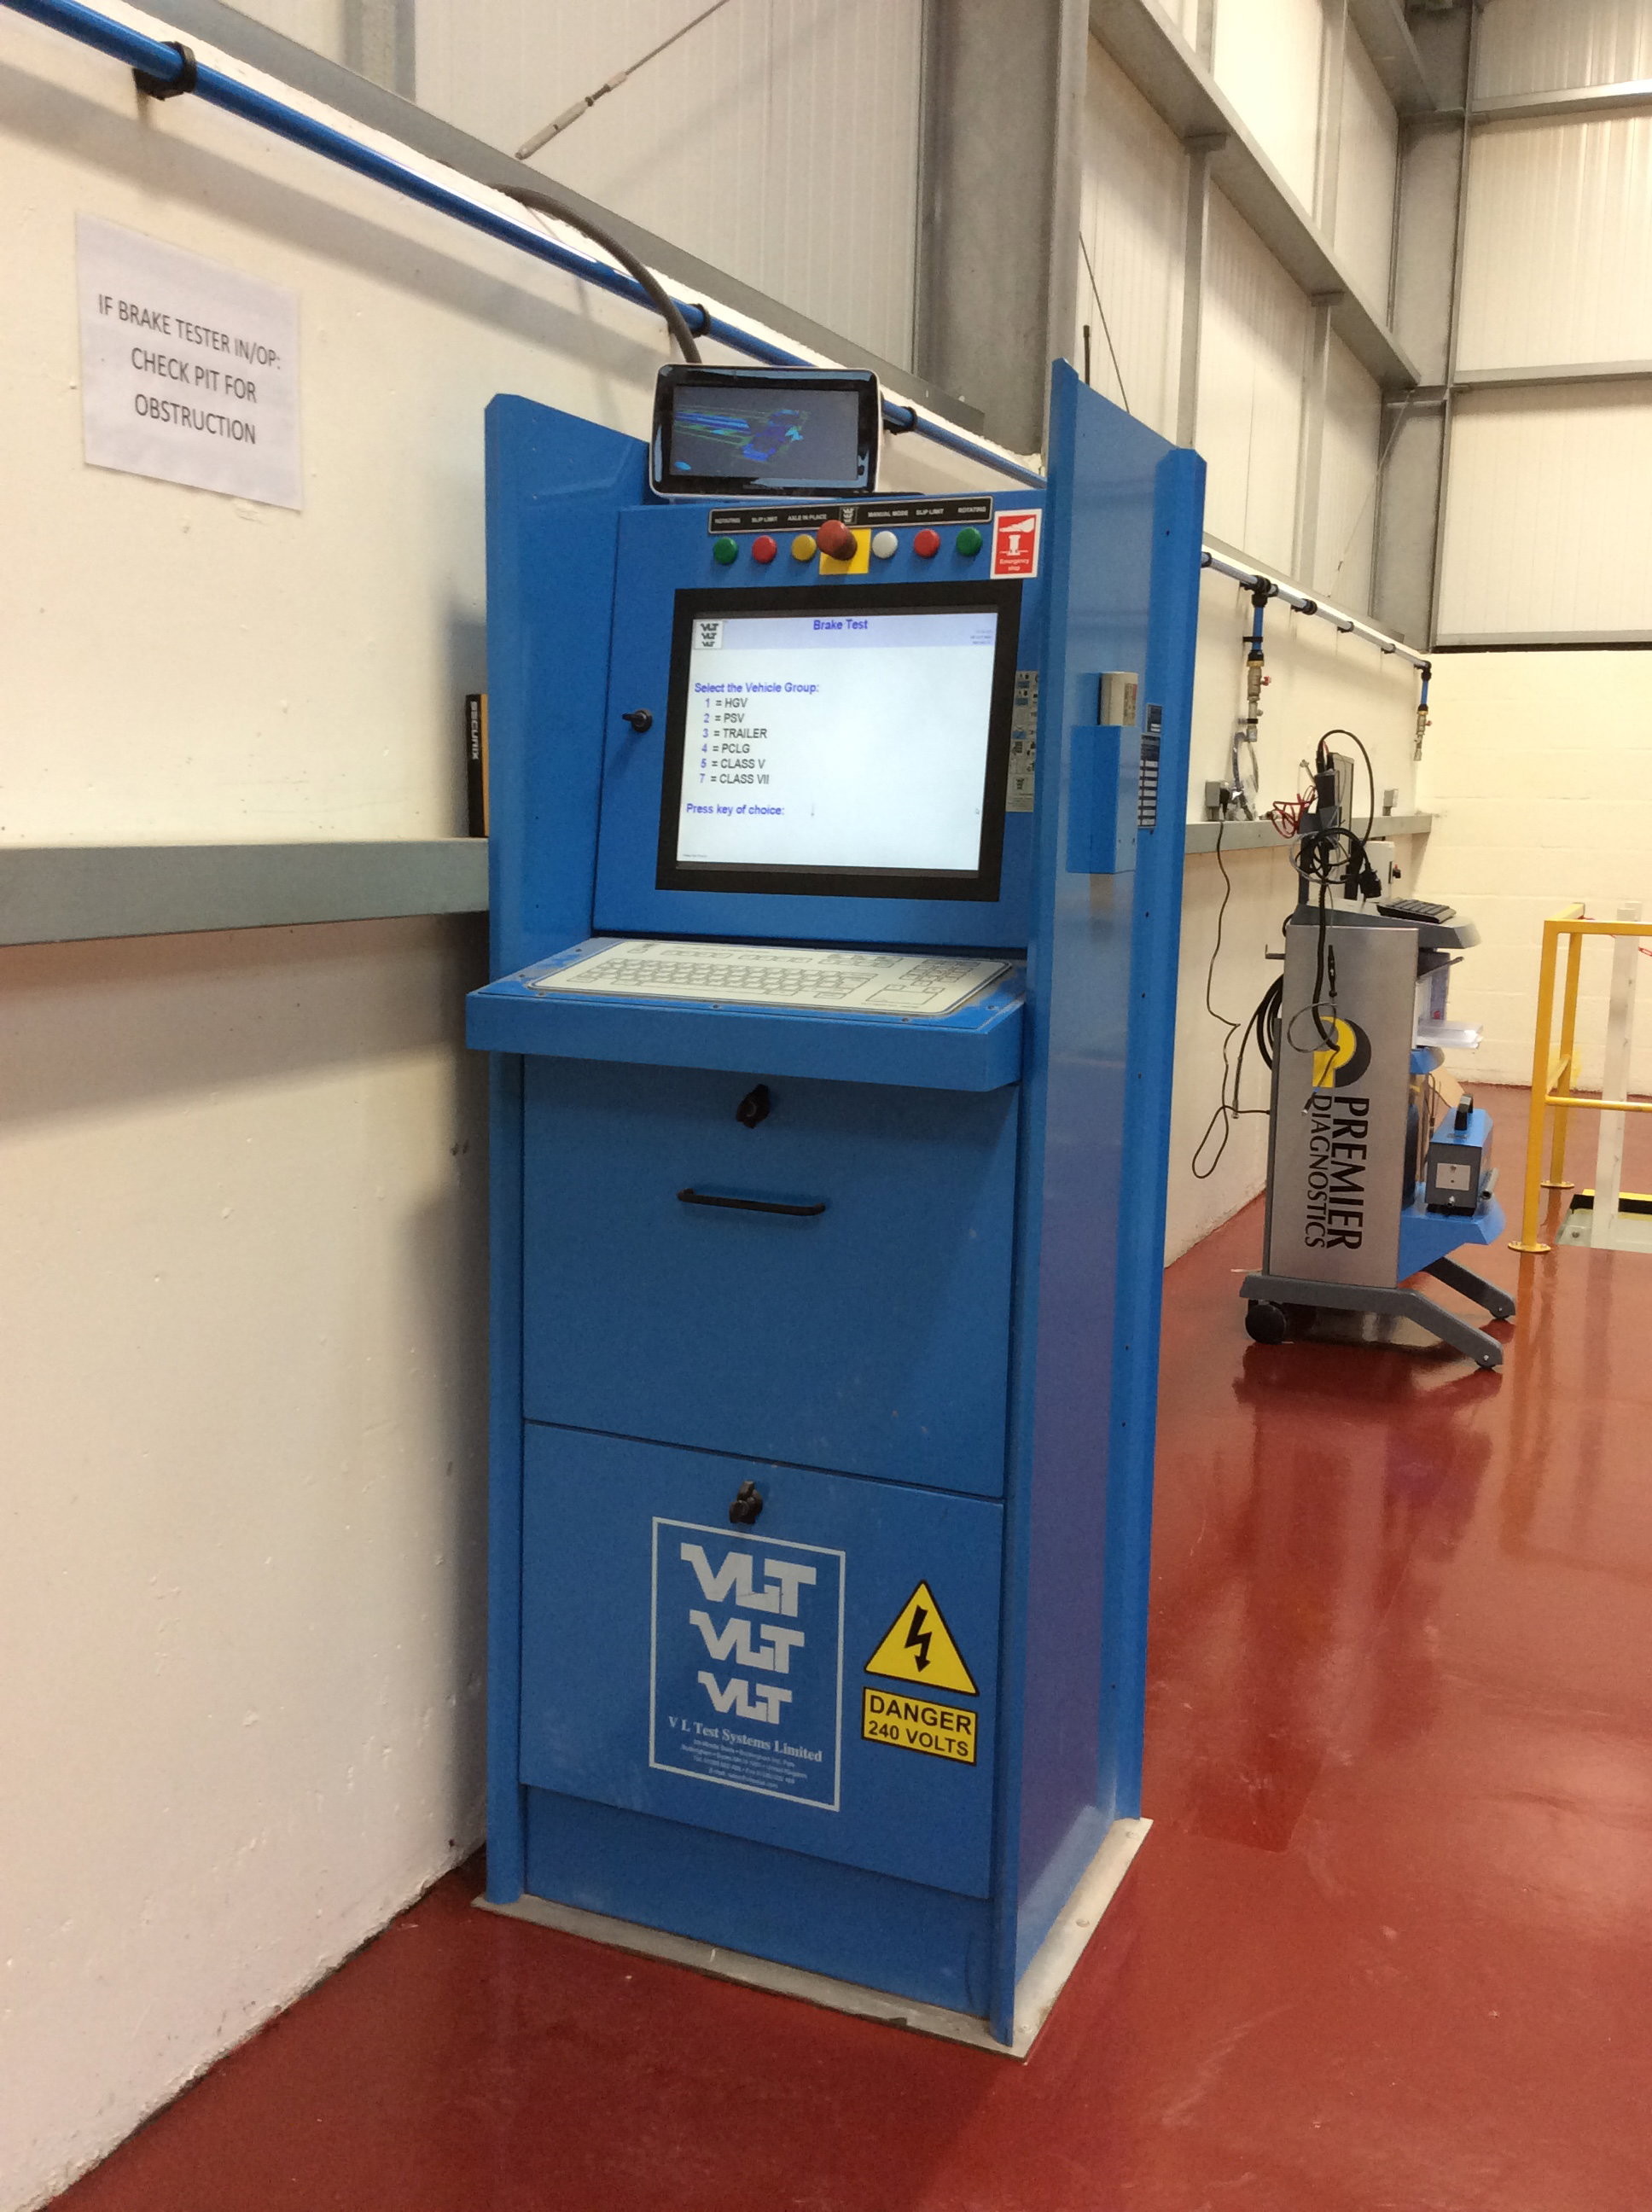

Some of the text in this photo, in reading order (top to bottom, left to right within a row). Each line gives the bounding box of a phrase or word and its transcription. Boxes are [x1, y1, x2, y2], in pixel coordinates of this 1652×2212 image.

[98, 294, 113, 316] IF
[119, 300, 171, 335] BRAKE
[176, 318, 230, 353] TESTER
[131, 347, 257, 403] CHECK PIT FOR
[135, 393, 256, 444] OBSTRUCTION
[999, 557, 1029, 567] Emergency
[813, 619, 868, 630] Brake Test
[695, 682, 819, 695] Select the Vehicle Group:
[705, 698, 710, 707] 1
[724, 698, 747, 707] HGV
[702, 728, 709, 738] 3
[724, 728, 768, 738] TRAILER
[703, 713, 710, 723] 2
[724, 713, 745, 723] PSV
[701, 743, 707, 754] 4
[721, 743, 751, 754] PCLG
[701, 759, 707, 768] 5
[720, 759, 755, 769] CLASS
[758, 759, 765, 769] V
[700, 773, 706, 783] 7
[719, 774, 754, 784] CLASS
[686, 803, 785, 817] Press key of choice:
[1305, 1095, 1333, 1248] DIAGNOSTICS
[1326, 1096, 1370, 1250] PREMIER
[680, 1542, 817, 1618] VLT
[689, 1609, 805, 1674] VLT
[697, 1670, 792, 1725] VLT
[870, 1694, 972, 1735] DANGER
[668, 1715, 678, 1728] V
[681, 1719, 690, 1732] L
[693, 1721, 718, 1738] Test
[722, 1728, 771, 1750] Systems
[774, 1740, 823, 1762] Limited
[869, 1720, 969, 1756] 240 VOLTS
